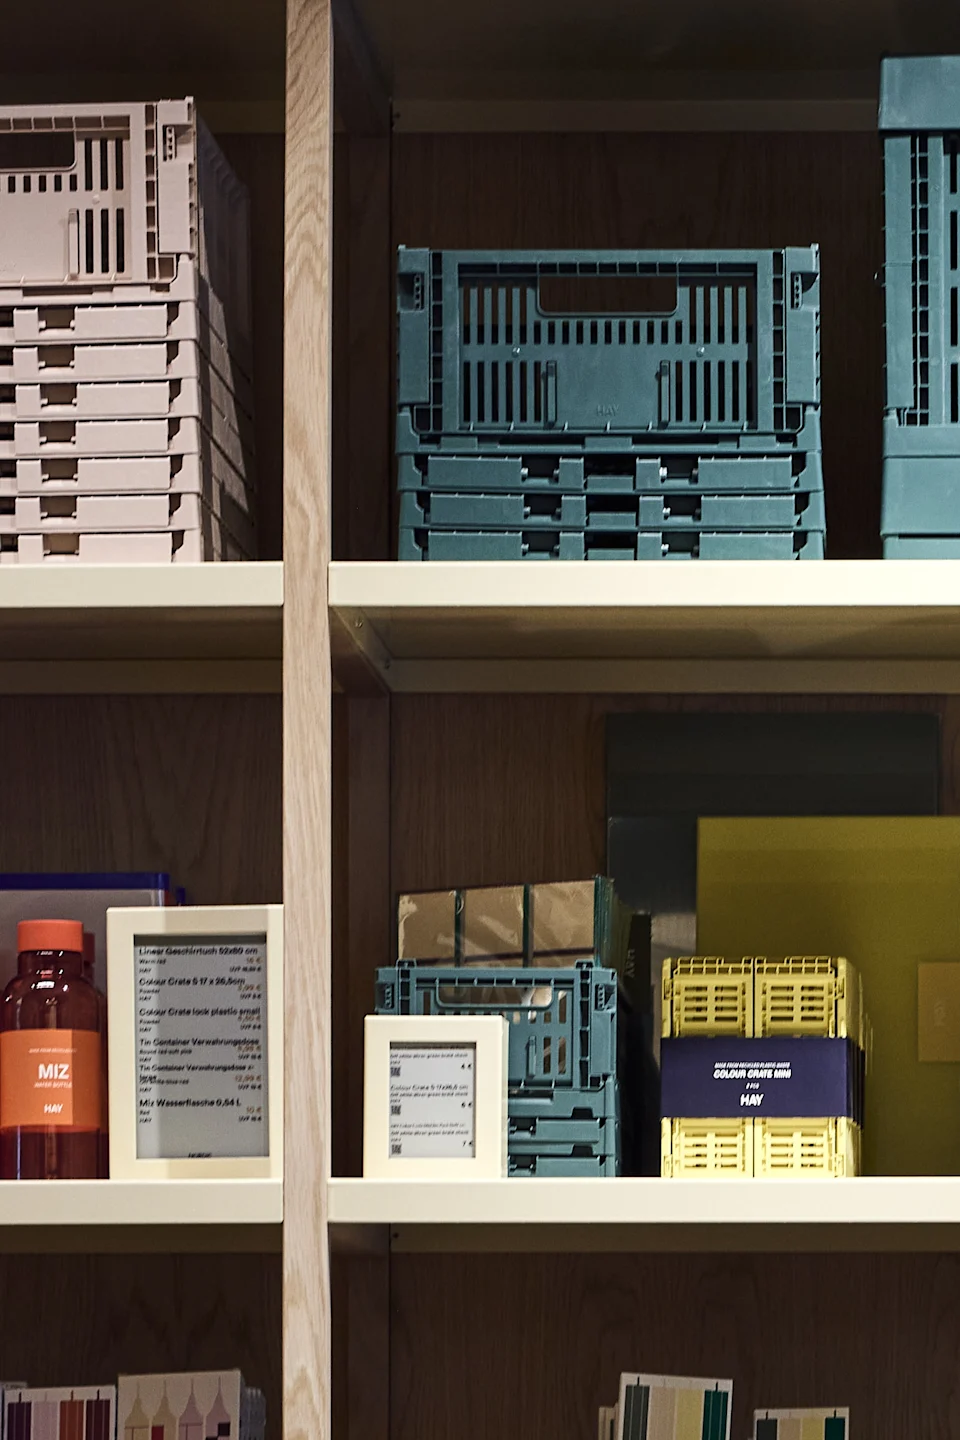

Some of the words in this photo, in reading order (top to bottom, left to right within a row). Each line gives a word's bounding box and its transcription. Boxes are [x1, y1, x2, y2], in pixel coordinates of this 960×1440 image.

[38, 1064, 70, 1080] MIZ
[713, 1069, 746, 1079] COLOUR
[746, 1069, 773, 1079] CRATE
[740, 1094, 764, 1106] HAY
[44, 1104, 64, 1114] HAY
